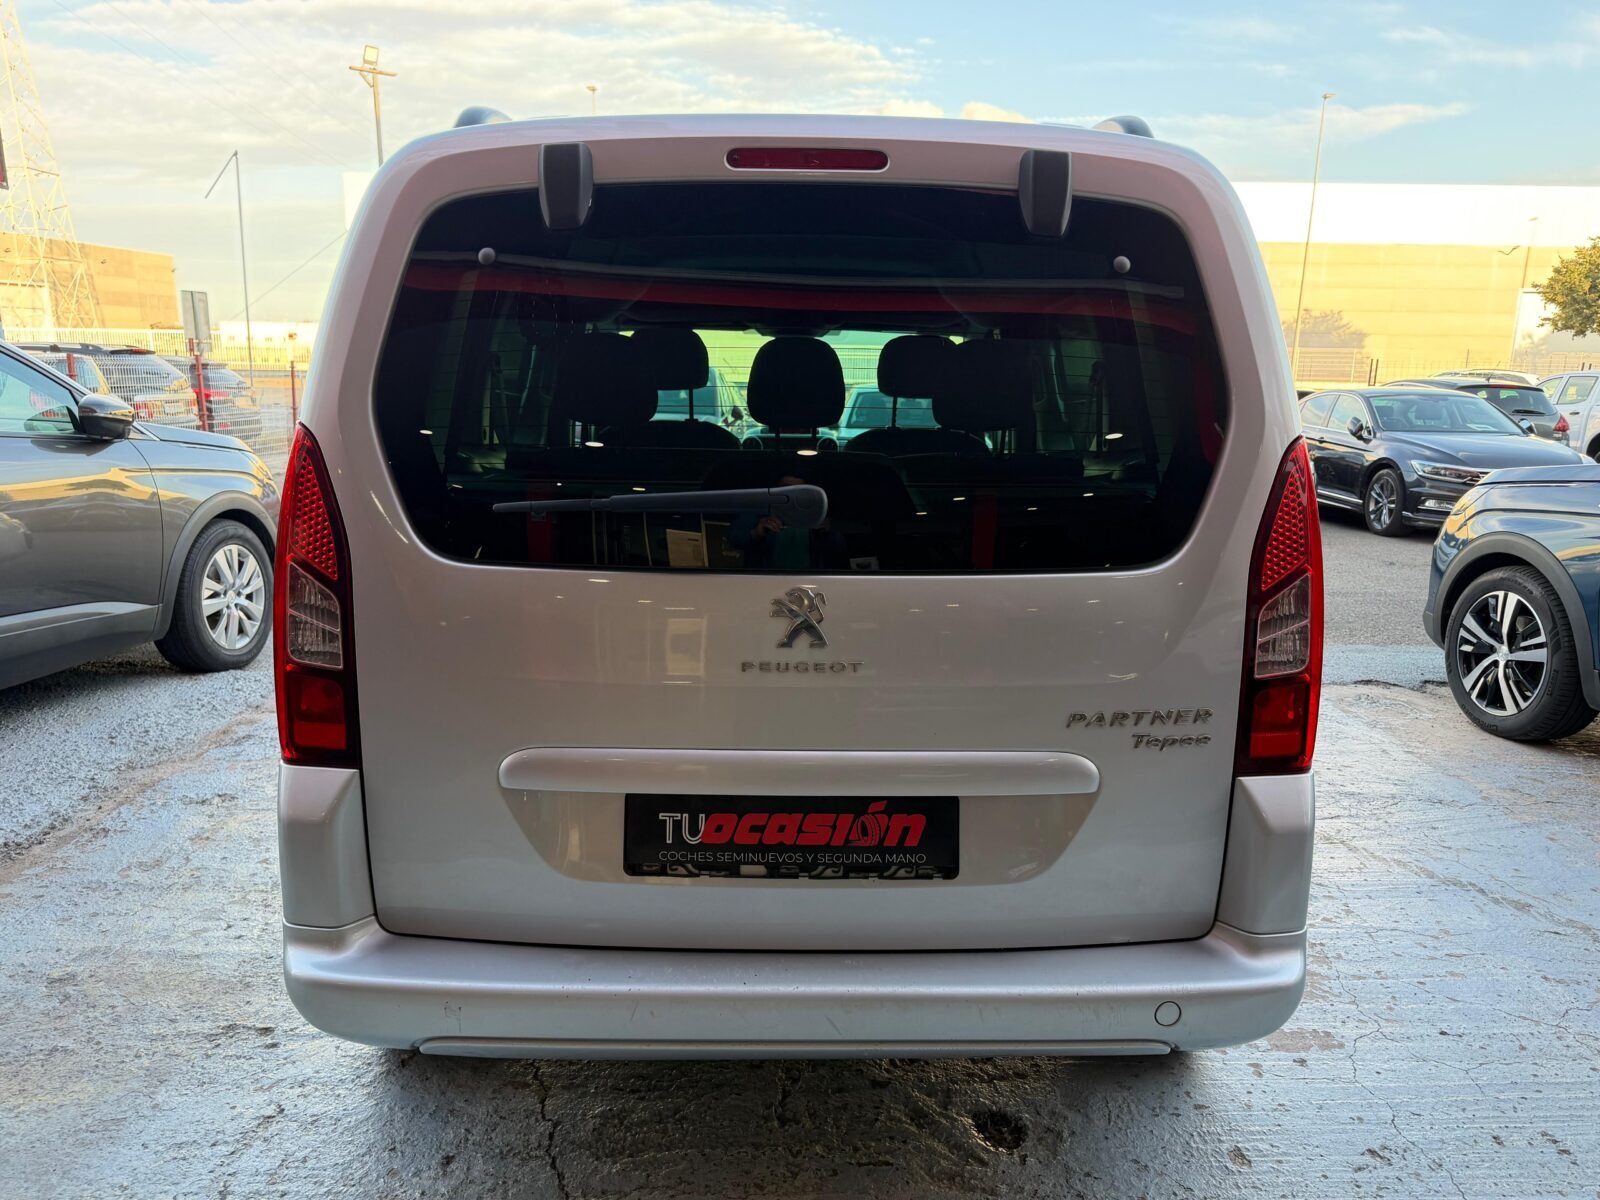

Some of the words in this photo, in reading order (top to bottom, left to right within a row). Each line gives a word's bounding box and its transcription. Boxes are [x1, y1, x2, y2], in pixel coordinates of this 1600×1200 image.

[740, 661, 865, 674] PEUGEOT
[1065, 708, 1215, 729] PARTNER
[1131, 733, 1212, 752] Tepee
[658, 850, 714, 862] COCHES
[716, 852, 804, 864] SEMINUEVOS
[806, 853, 815, 864] Y
[817, 853, 883, 864] SEGUNDA
[885, 853, 927, 864] MANO
